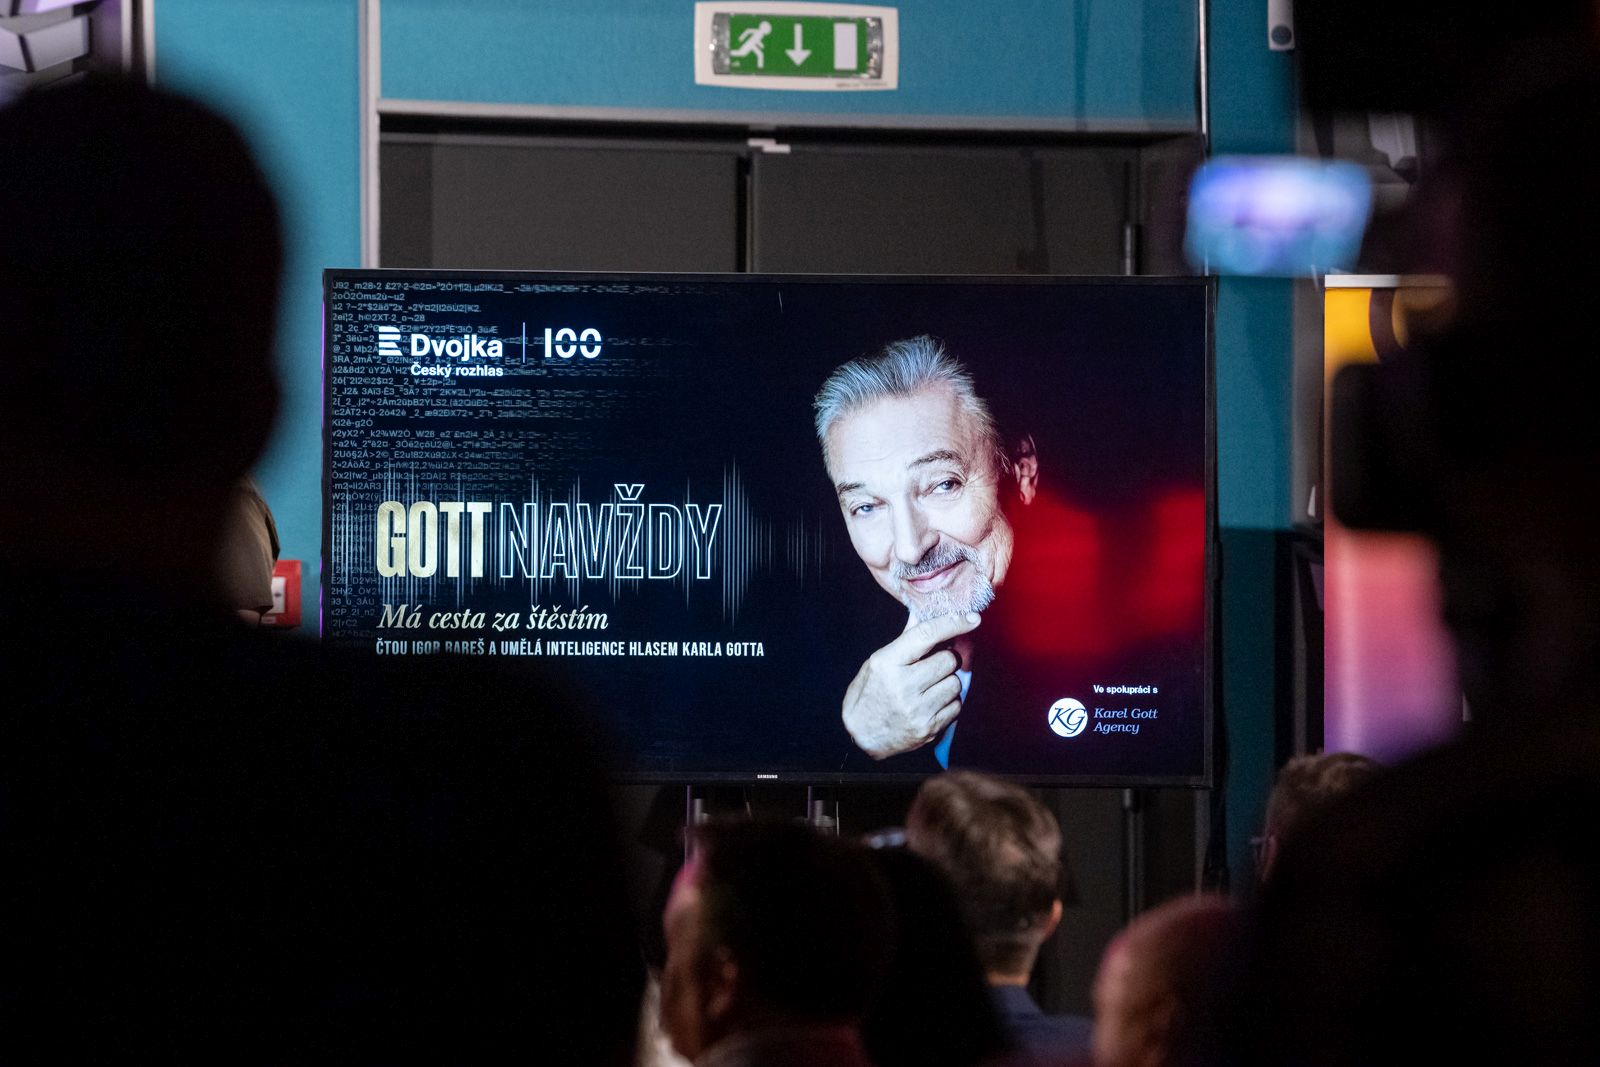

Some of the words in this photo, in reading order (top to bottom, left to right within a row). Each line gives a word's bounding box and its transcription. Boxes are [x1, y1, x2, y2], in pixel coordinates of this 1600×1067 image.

[411, 333, 503, 361] Dvojka
[544, 328, 602, 358] 100
[411, 361, 452, 378] Český
[456, 365, 504, 377] rozhlas
[376, 501, 492, 578] GOTT
[500, 484, 723, 579] NAVŽDY
[376, 604, 422, 629] Má
[429, 608, 485, 629] cesta
[492, 612, 521, 632] za
[526, 604, 609, 630] štěstím
[376, 638, 408, 655] ČTOU
[412, 640, 441, 655] IGOR
[489, 641, 497, 655] A
[500, 638, 543, 656] UMĚLÁ
[547, 641, 625, 656] INTELIGENCE
[629, 642, 678, 656] HLASEM
[682, 642, 722, 657] KARLA
[726, 642, 764, 657] GOTTA
[1093, 684, 1104, 694] Ve
[1106, 685, 1151, 695] spolupráci
[1050, 707, 1087, 734] KG
[1093, 708, 1128, 719] Karel
[1131, 708, 1158, 719] Gott
[1093, 722, 1140, 735] Agency
